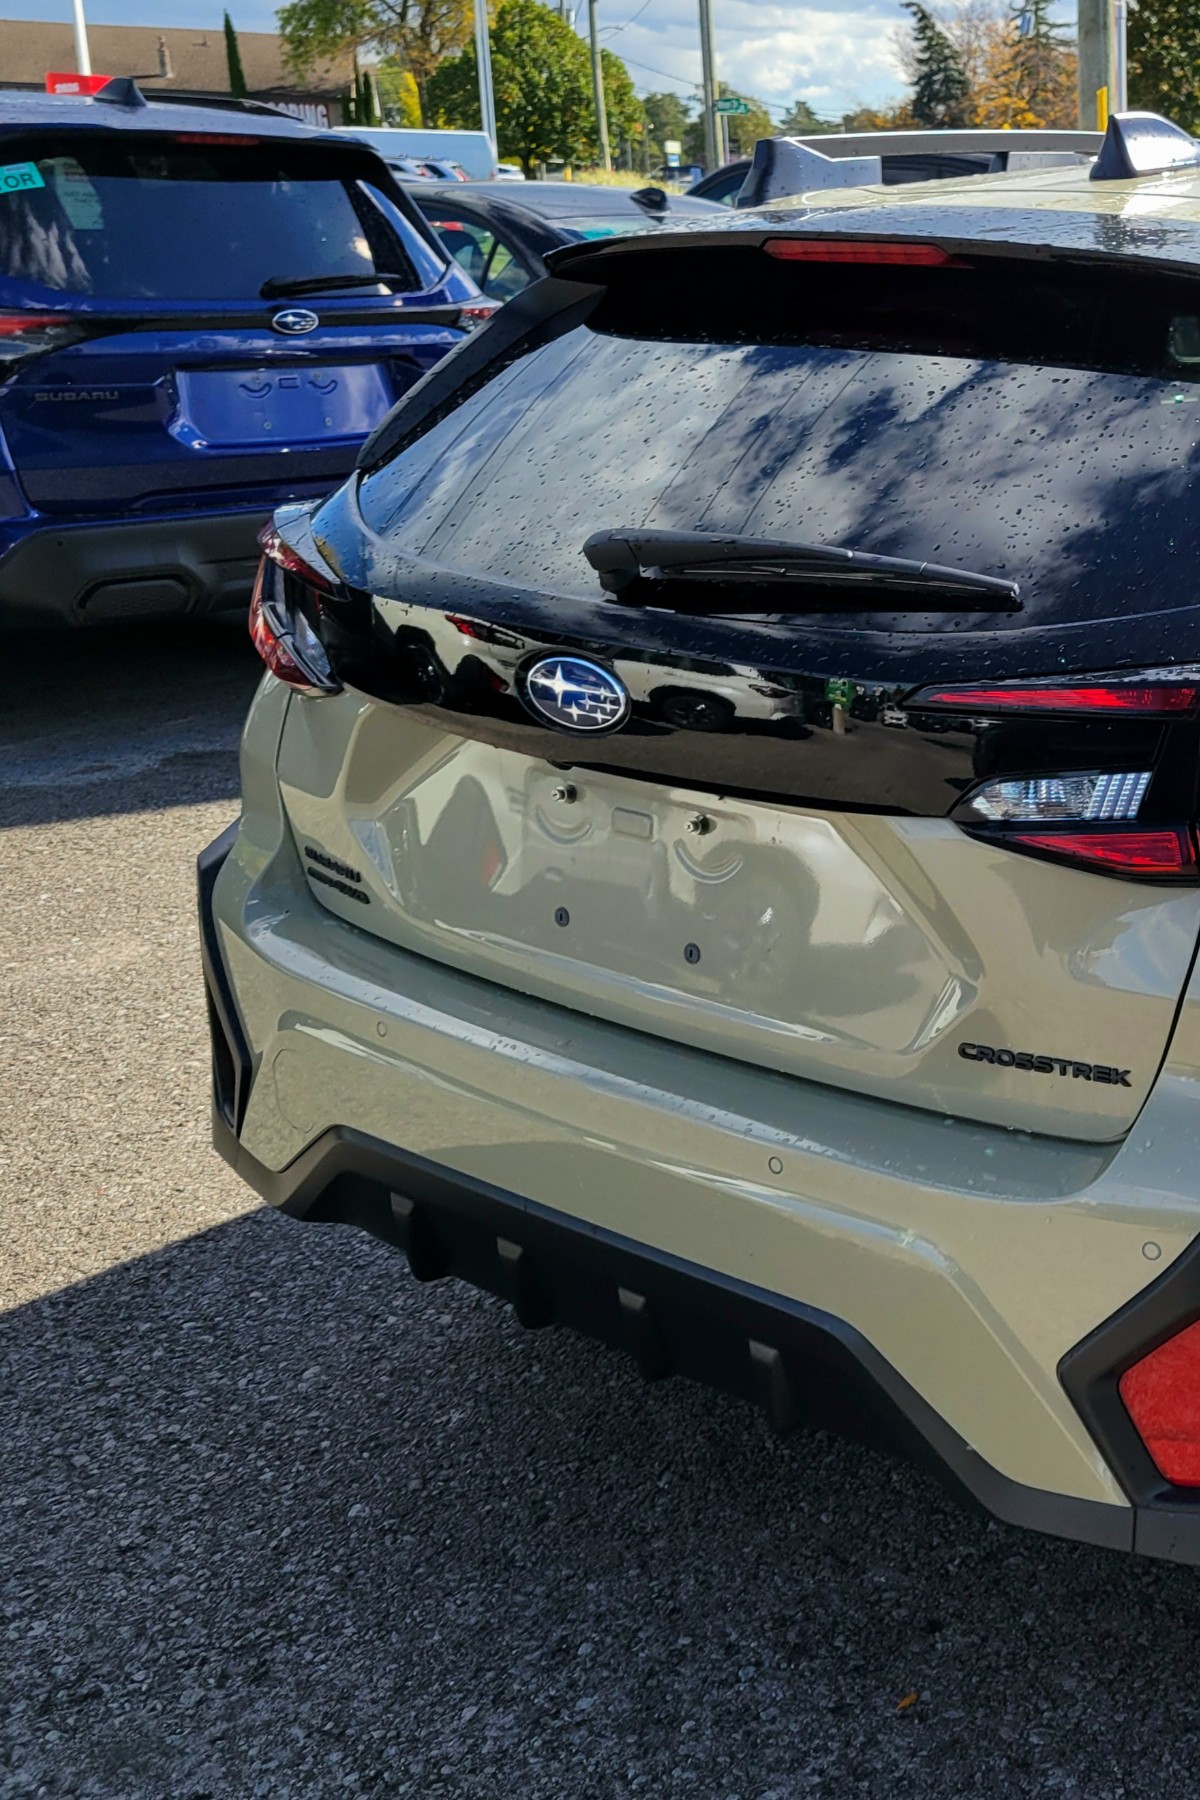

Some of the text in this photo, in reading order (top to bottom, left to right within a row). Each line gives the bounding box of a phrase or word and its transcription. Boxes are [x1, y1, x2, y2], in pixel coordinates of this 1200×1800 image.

[0, 172, 37, 191] OR
[34, 390, 119, 401] SUBARU
[957, 1042, 1132, 1088] CROSSTREK
